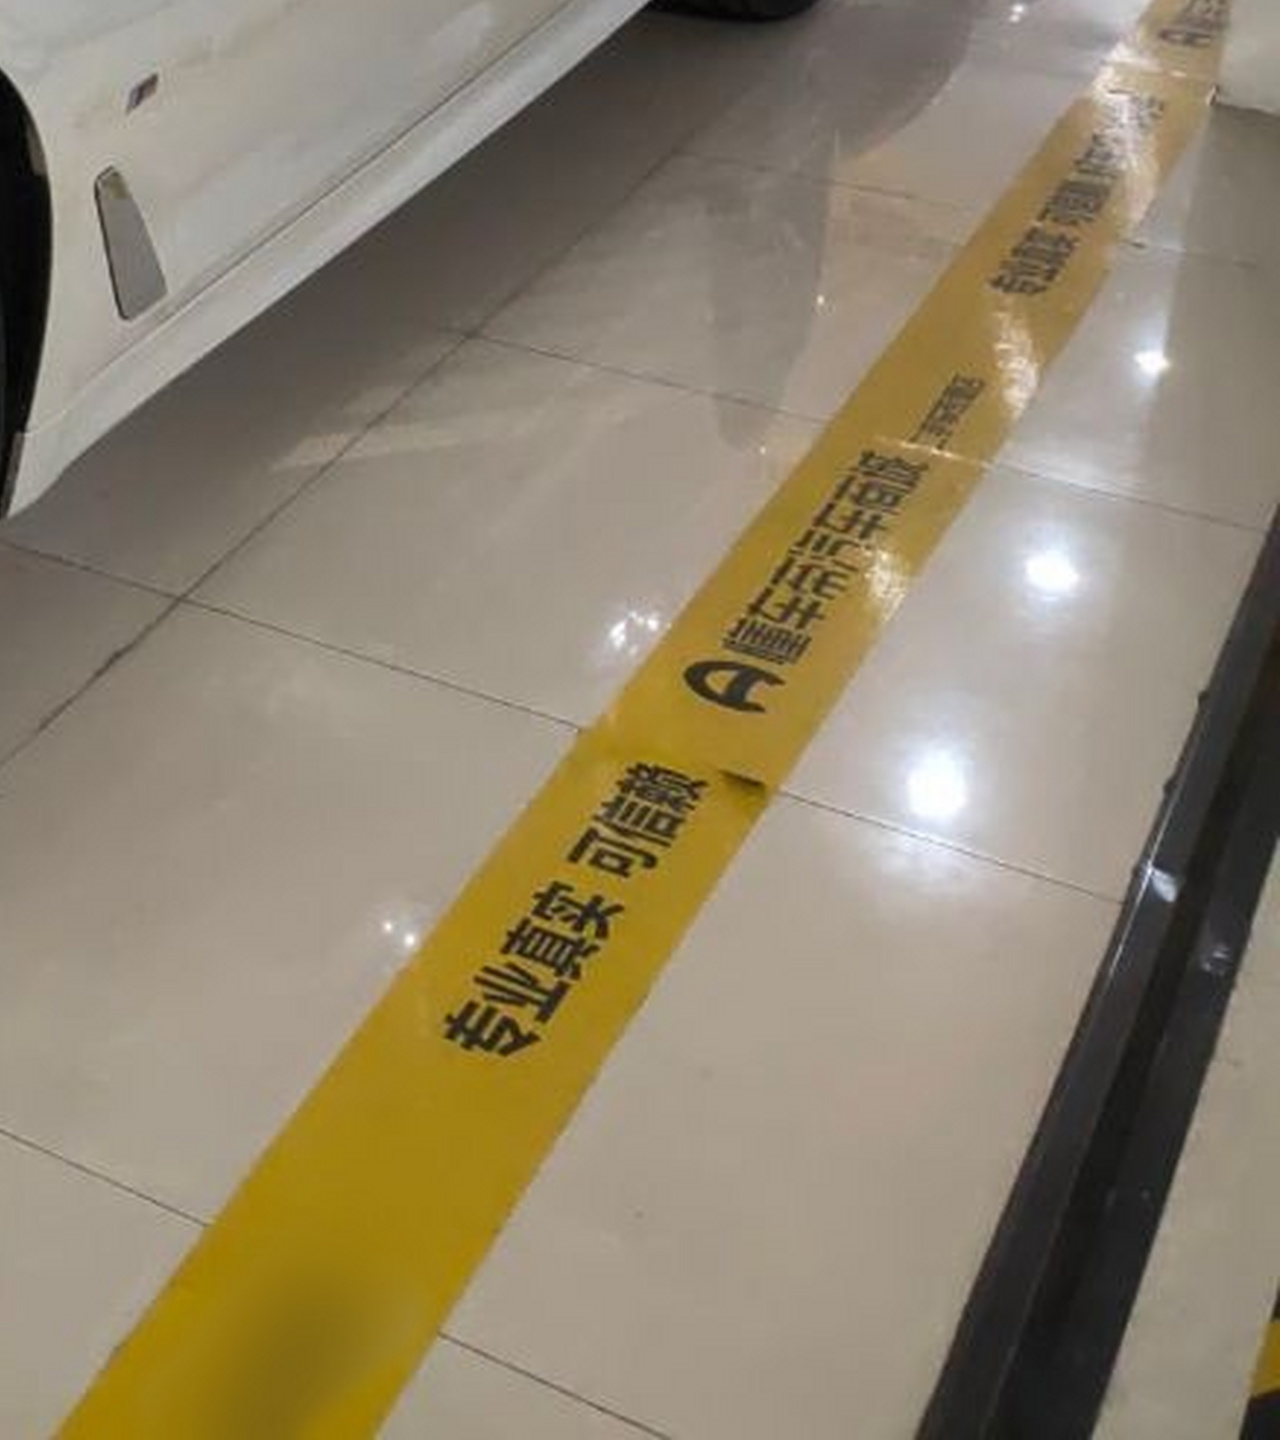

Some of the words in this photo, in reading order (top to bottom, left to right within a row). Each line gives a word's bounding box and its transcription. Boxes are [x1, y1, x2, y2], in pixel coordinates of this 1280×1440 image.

[443, 881, 625, 1058] 专业真实
[566, 763, 710, 879] 可信赖
